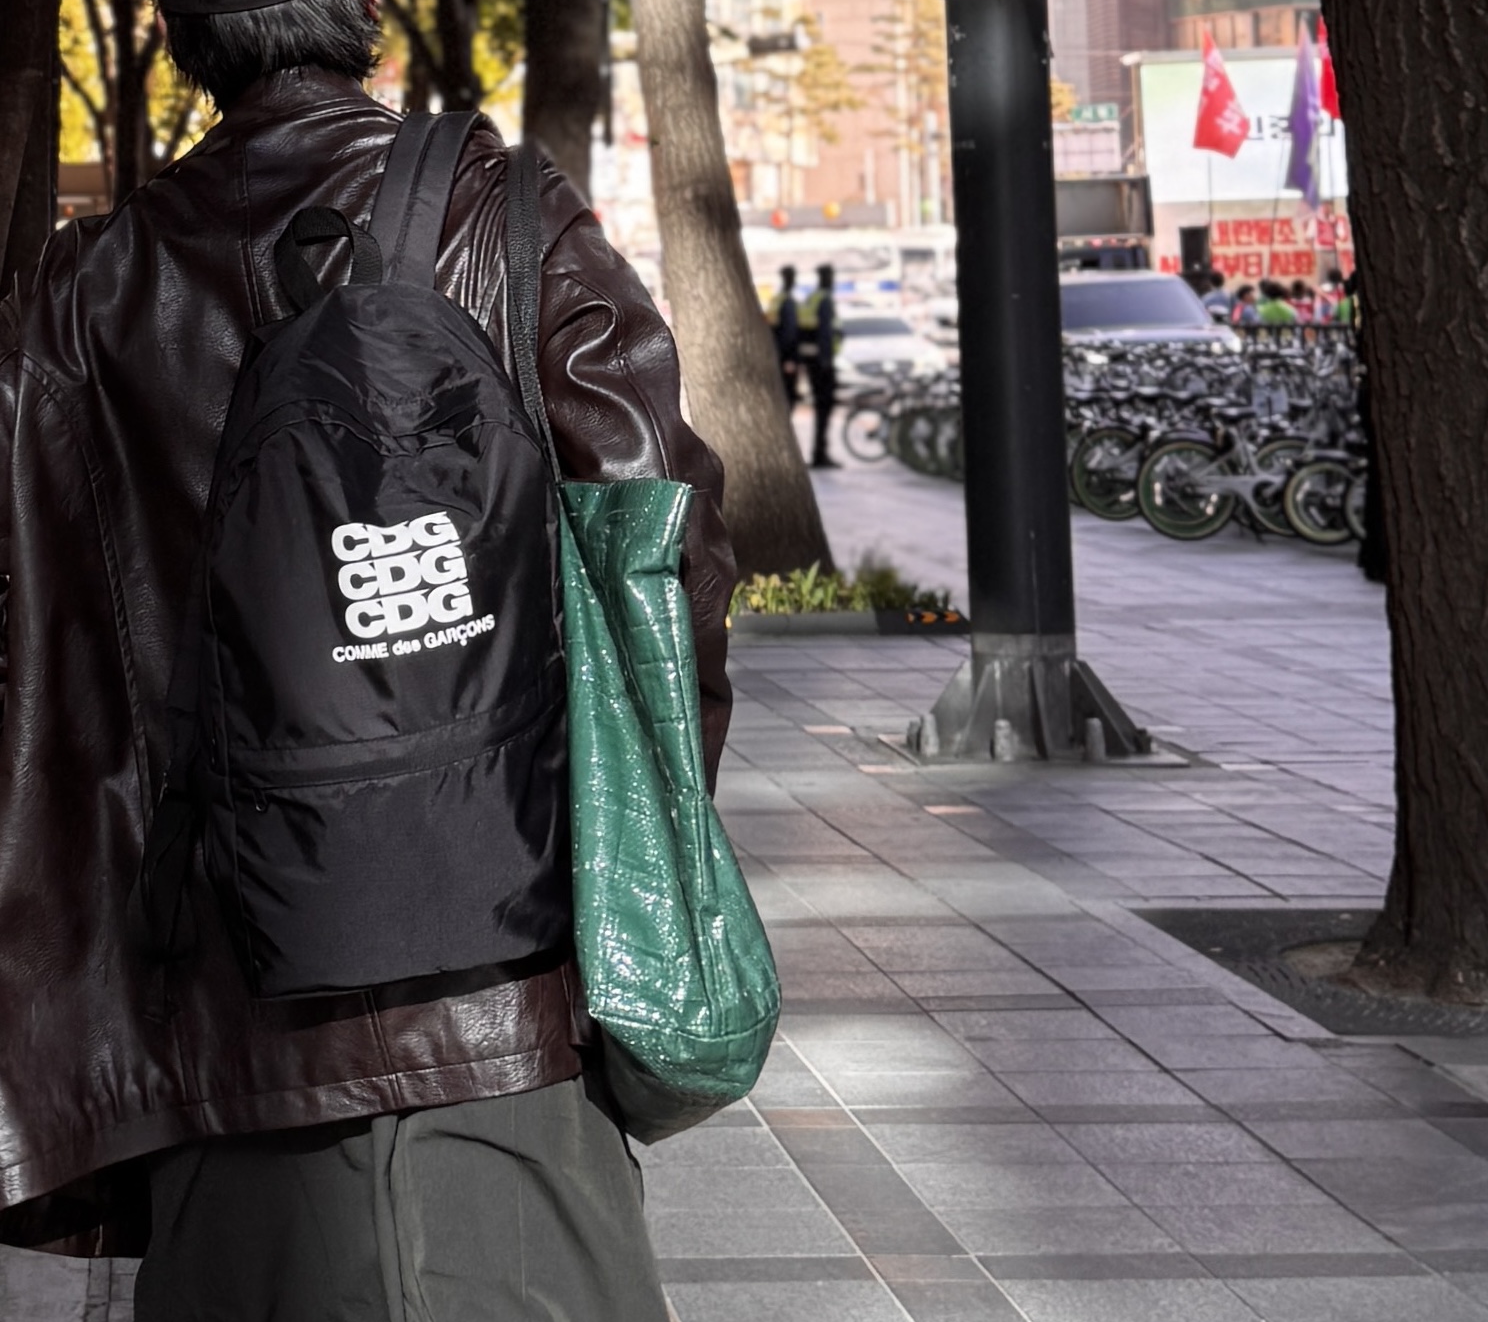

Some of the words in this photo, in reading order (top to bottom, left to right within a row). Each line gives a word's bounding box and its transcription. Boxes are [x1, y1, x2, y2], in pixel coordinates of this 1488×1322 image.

[331, 511, 461, 562] CDG
[338, 542, 469, 600] CDG
[344, 578, 474, 639] CDG
[332, 641, 389, 663] COMME
[392, 638, 422, 656] des
[423, 614, 496, 647] GARÇONS
